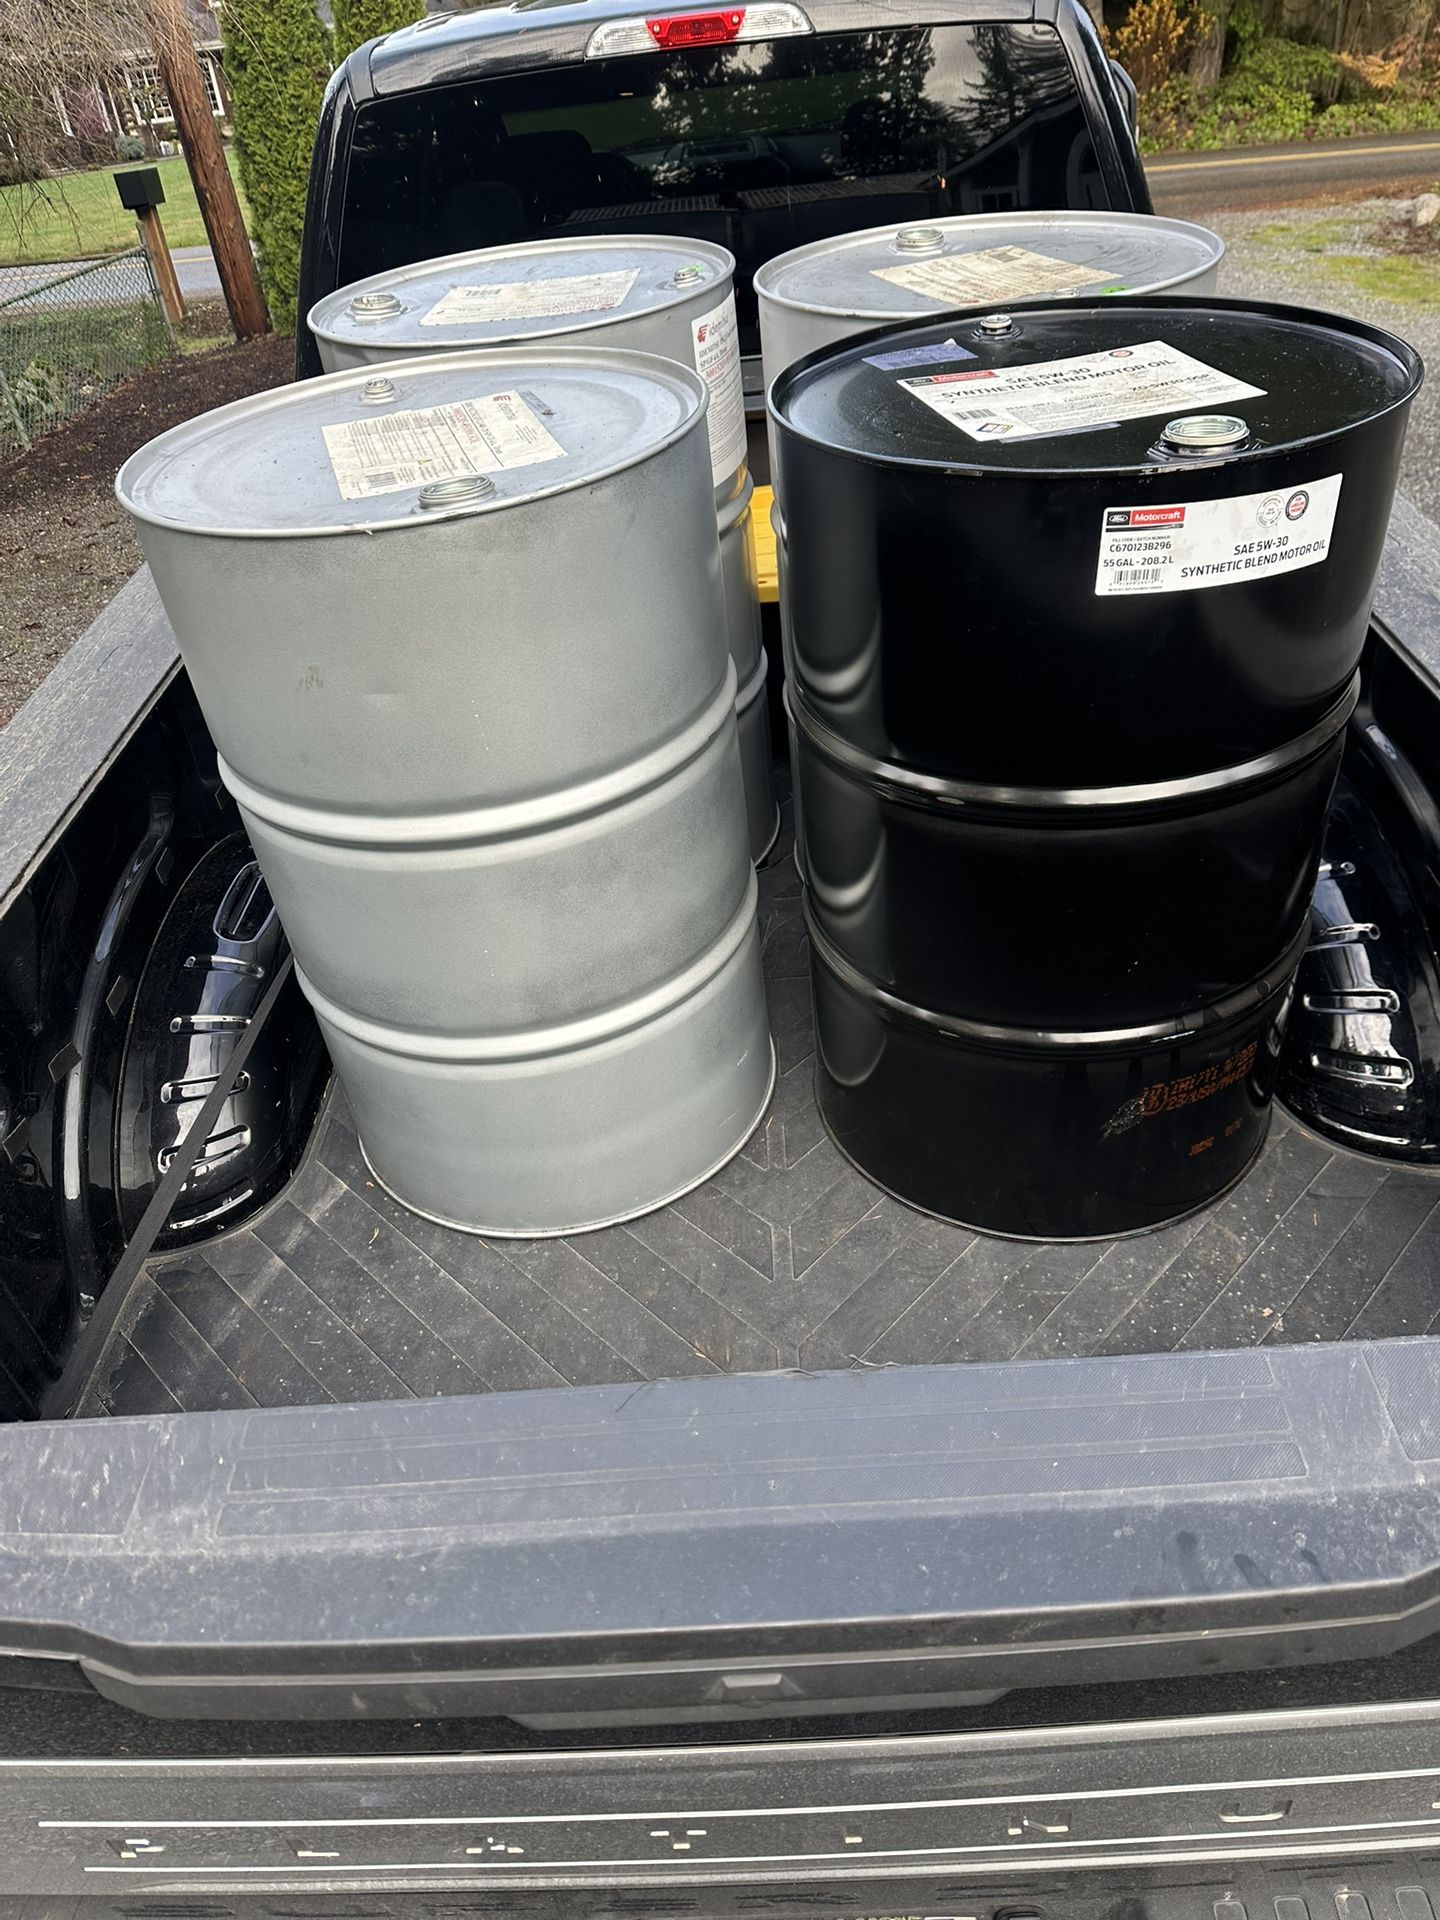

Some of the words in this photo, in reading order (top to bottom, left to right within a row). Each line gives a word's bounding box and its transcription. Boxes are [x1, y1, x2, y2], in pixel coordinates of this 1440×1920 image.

[941, 382, 1036, 399] SYNTHETIC
[1035, 375, 1087, 390] BLEND
[1087, 363, 1148, 380] MOTOR
[1148, 358, 1178, 369] OIL
[1005, 373, 1038, 386] SAE
[1038, 367, 1091, 382] 5W-30
[1135, 511, 1182, 522] Motorcraft
[1233, 543, 1256, 556] SAE
[1255, 535, 1289, 552] 5W-30
[1103, 558, 1115, 568] 55
[1116, 557, 1135, 567] GAL
[1141, 555, 1168, 566] 208.2
[1168, 555, 1174, 564] L
[1181, 559, 1243, 578] SYNTHETIC
[1244, 552, 1278, 569] BLEND
[1278, 544, 1311, 562] MOTOR
[1312, 538, 1326, 553] OIL
